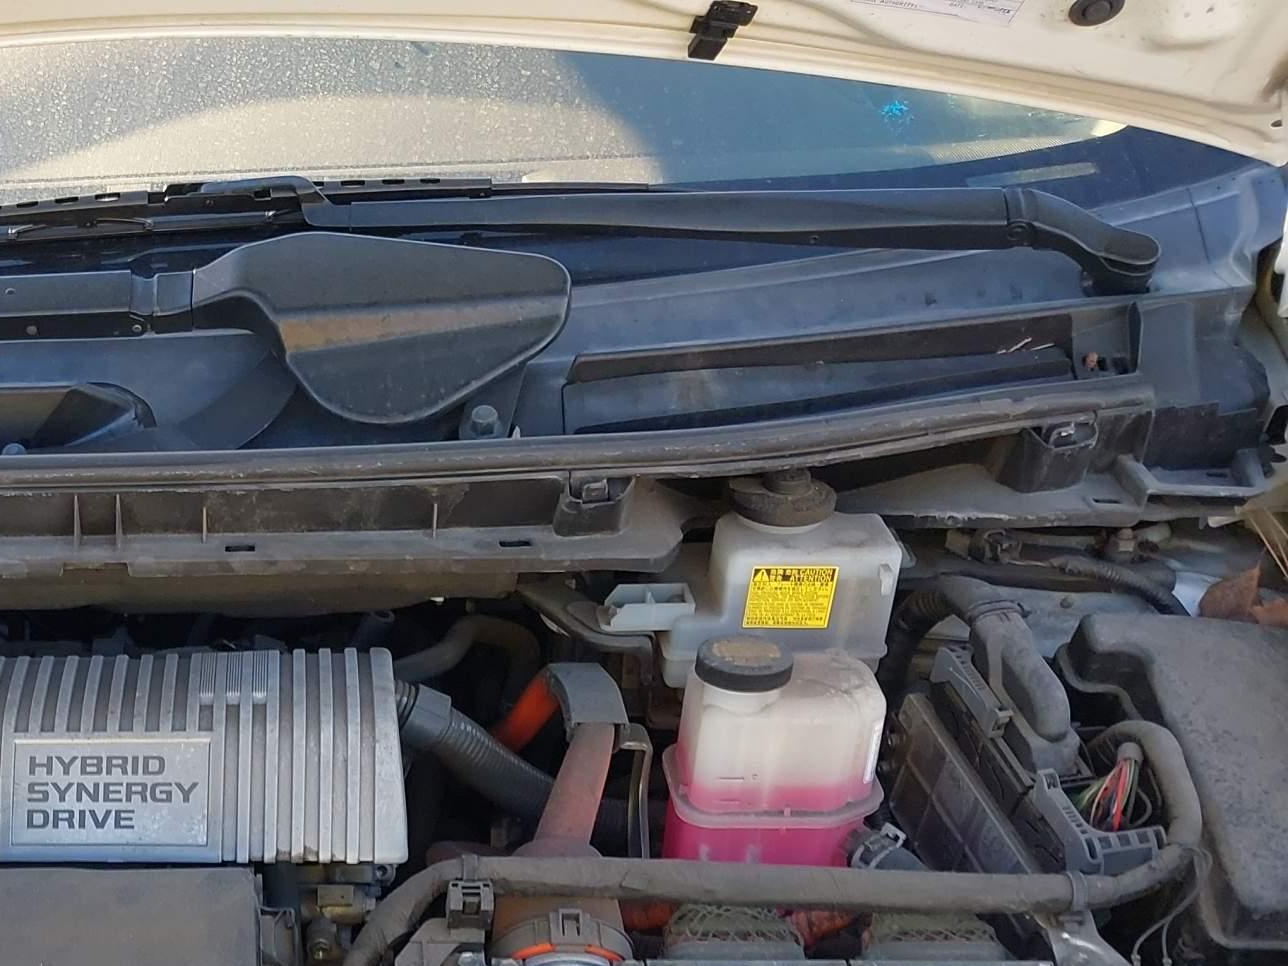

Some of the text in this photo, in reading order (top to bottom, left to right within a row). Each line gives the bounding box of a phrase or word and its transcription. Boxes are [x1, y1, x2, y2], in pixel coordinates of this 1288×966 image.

[28, 755, 166, 776] HYBRID
[27, 782, 198, 803] SYNERGY
[26, 809, 136, 830] DRIVE
